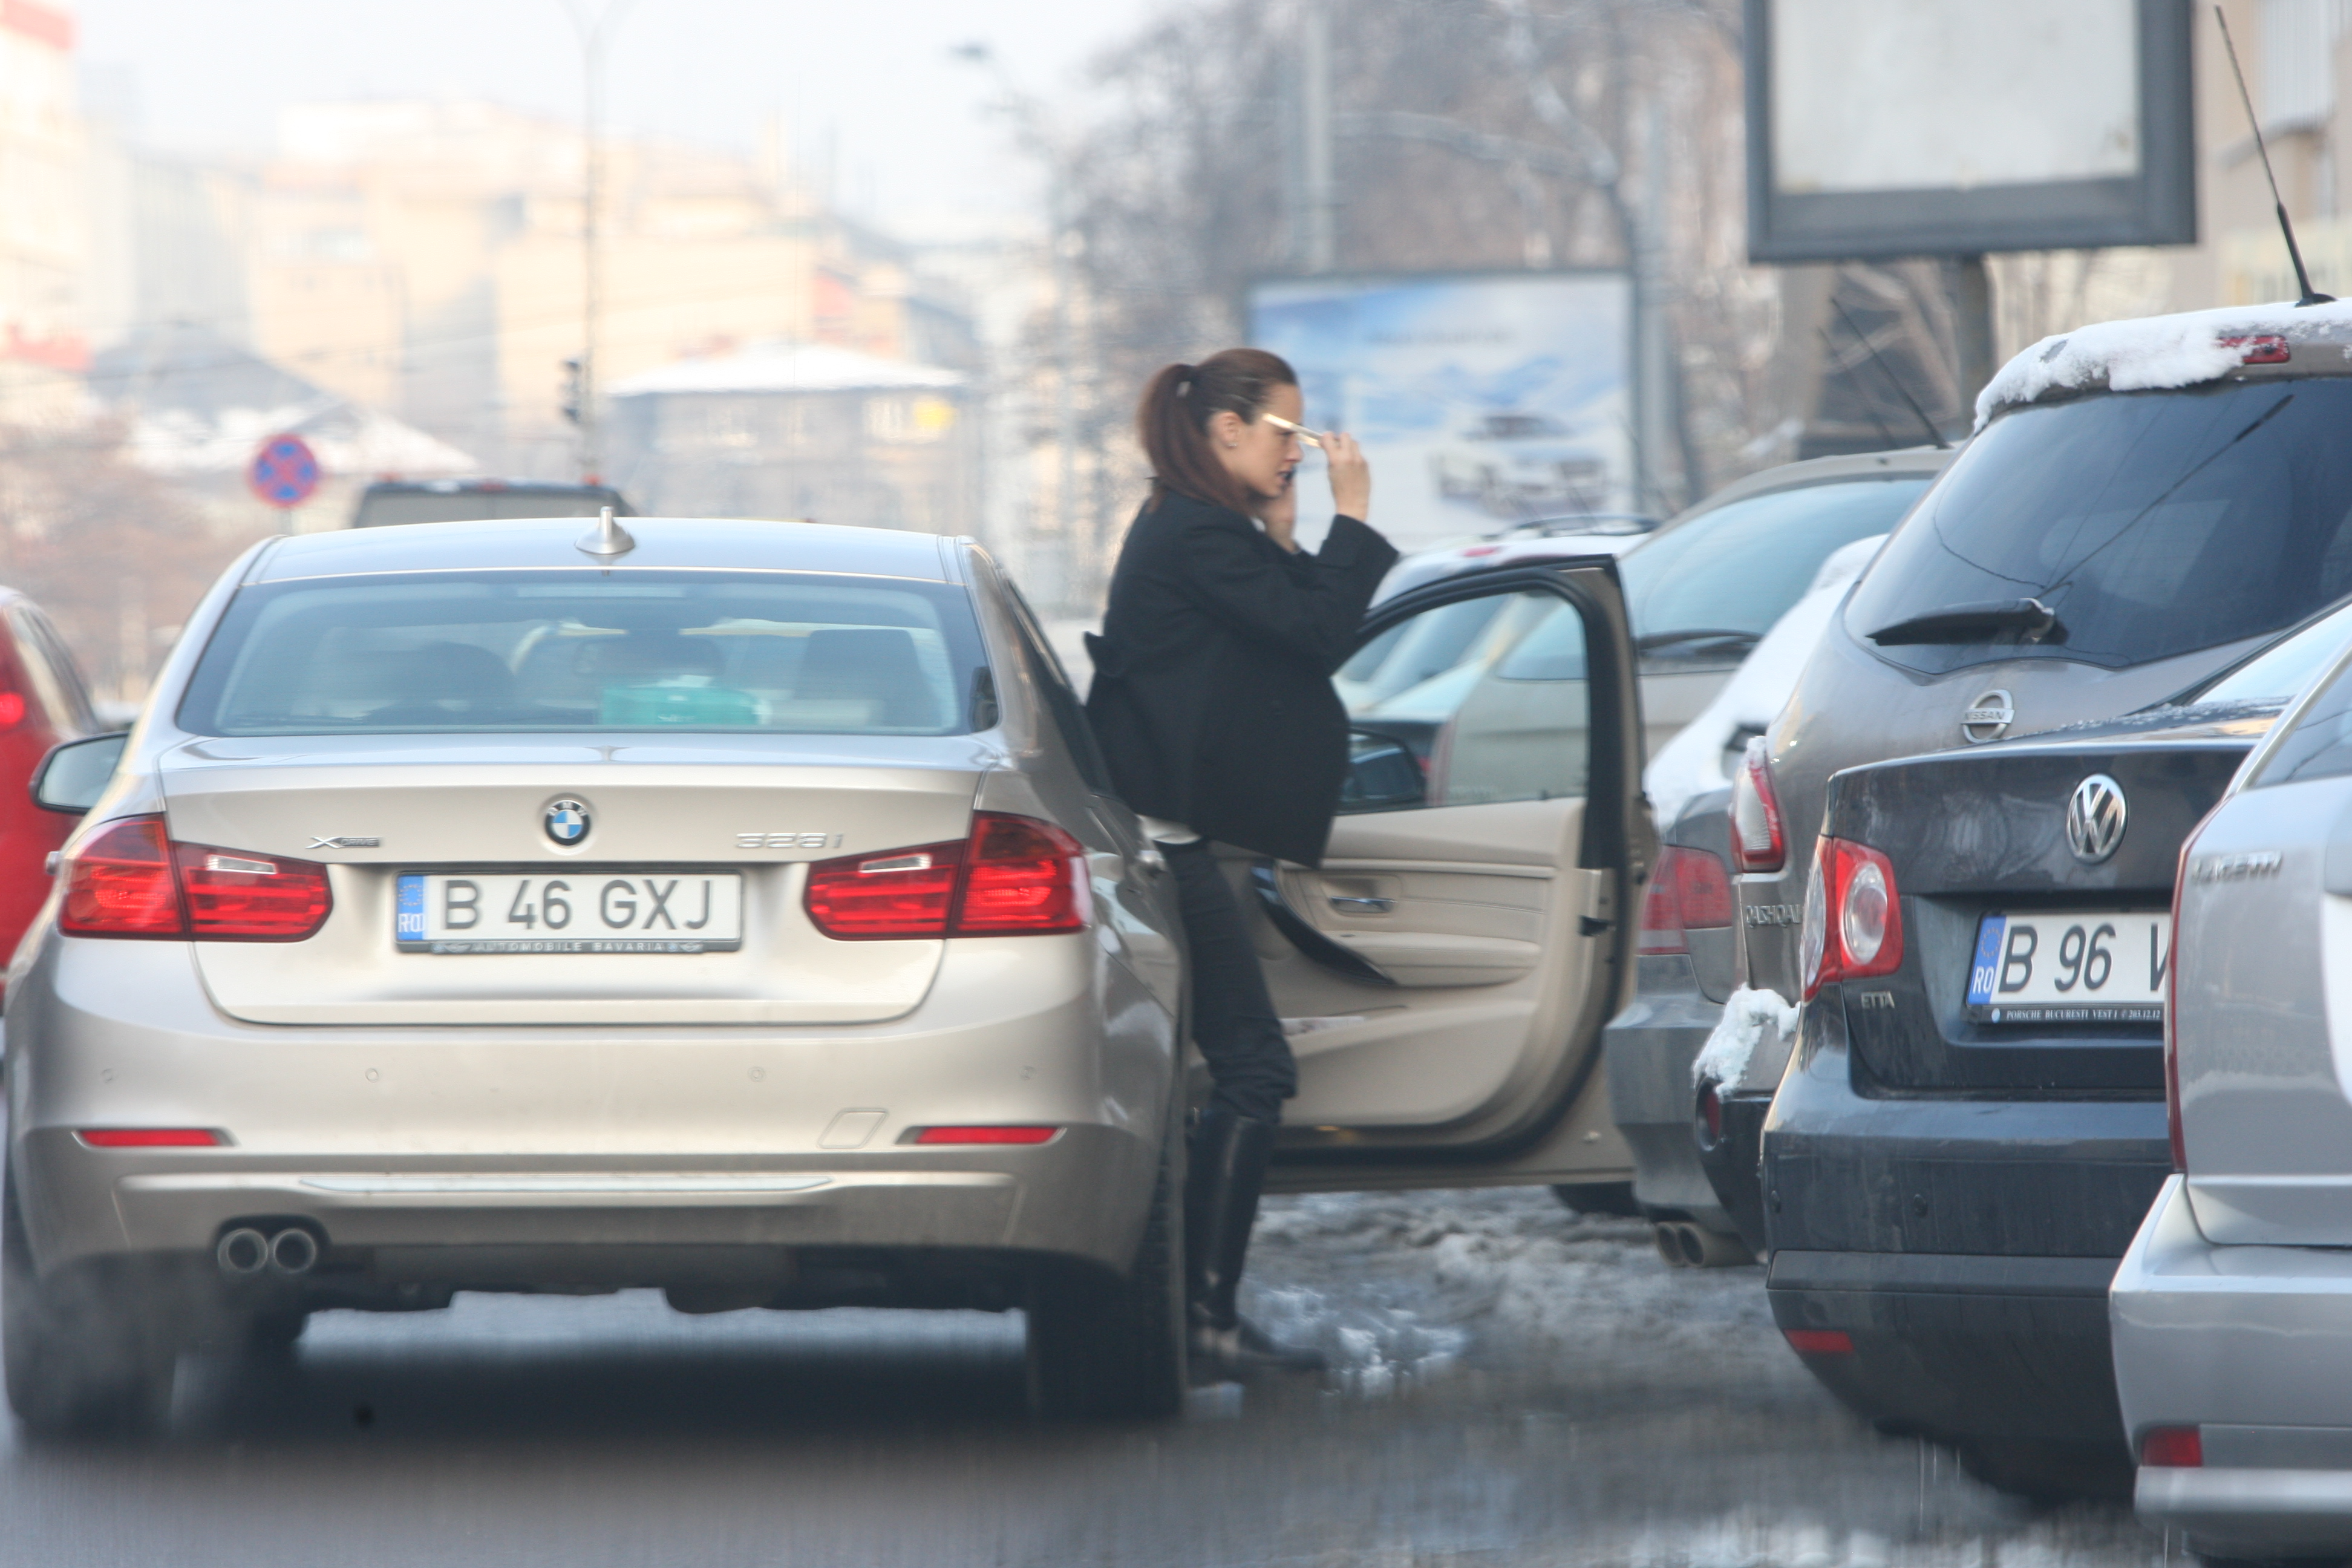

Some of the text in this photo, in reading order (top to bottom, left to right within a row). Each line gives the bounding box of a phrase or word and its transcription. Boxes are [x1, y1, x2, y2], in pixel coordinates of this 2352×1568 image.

[546, 802, 588, 817] BMW
[443, 879, 712, 930] B 46 GXJ
[397, 912, 425, 933] RO
[471, 942, 664, 952] AUTOMOBILE BAVARIA
[1998, 925, 2039, 993] B
[2054, 923, 2117, 992] 96
[1973, 965, 1995, 995] RO
[2007, 1009, 2042, 1020] PORSCHE
